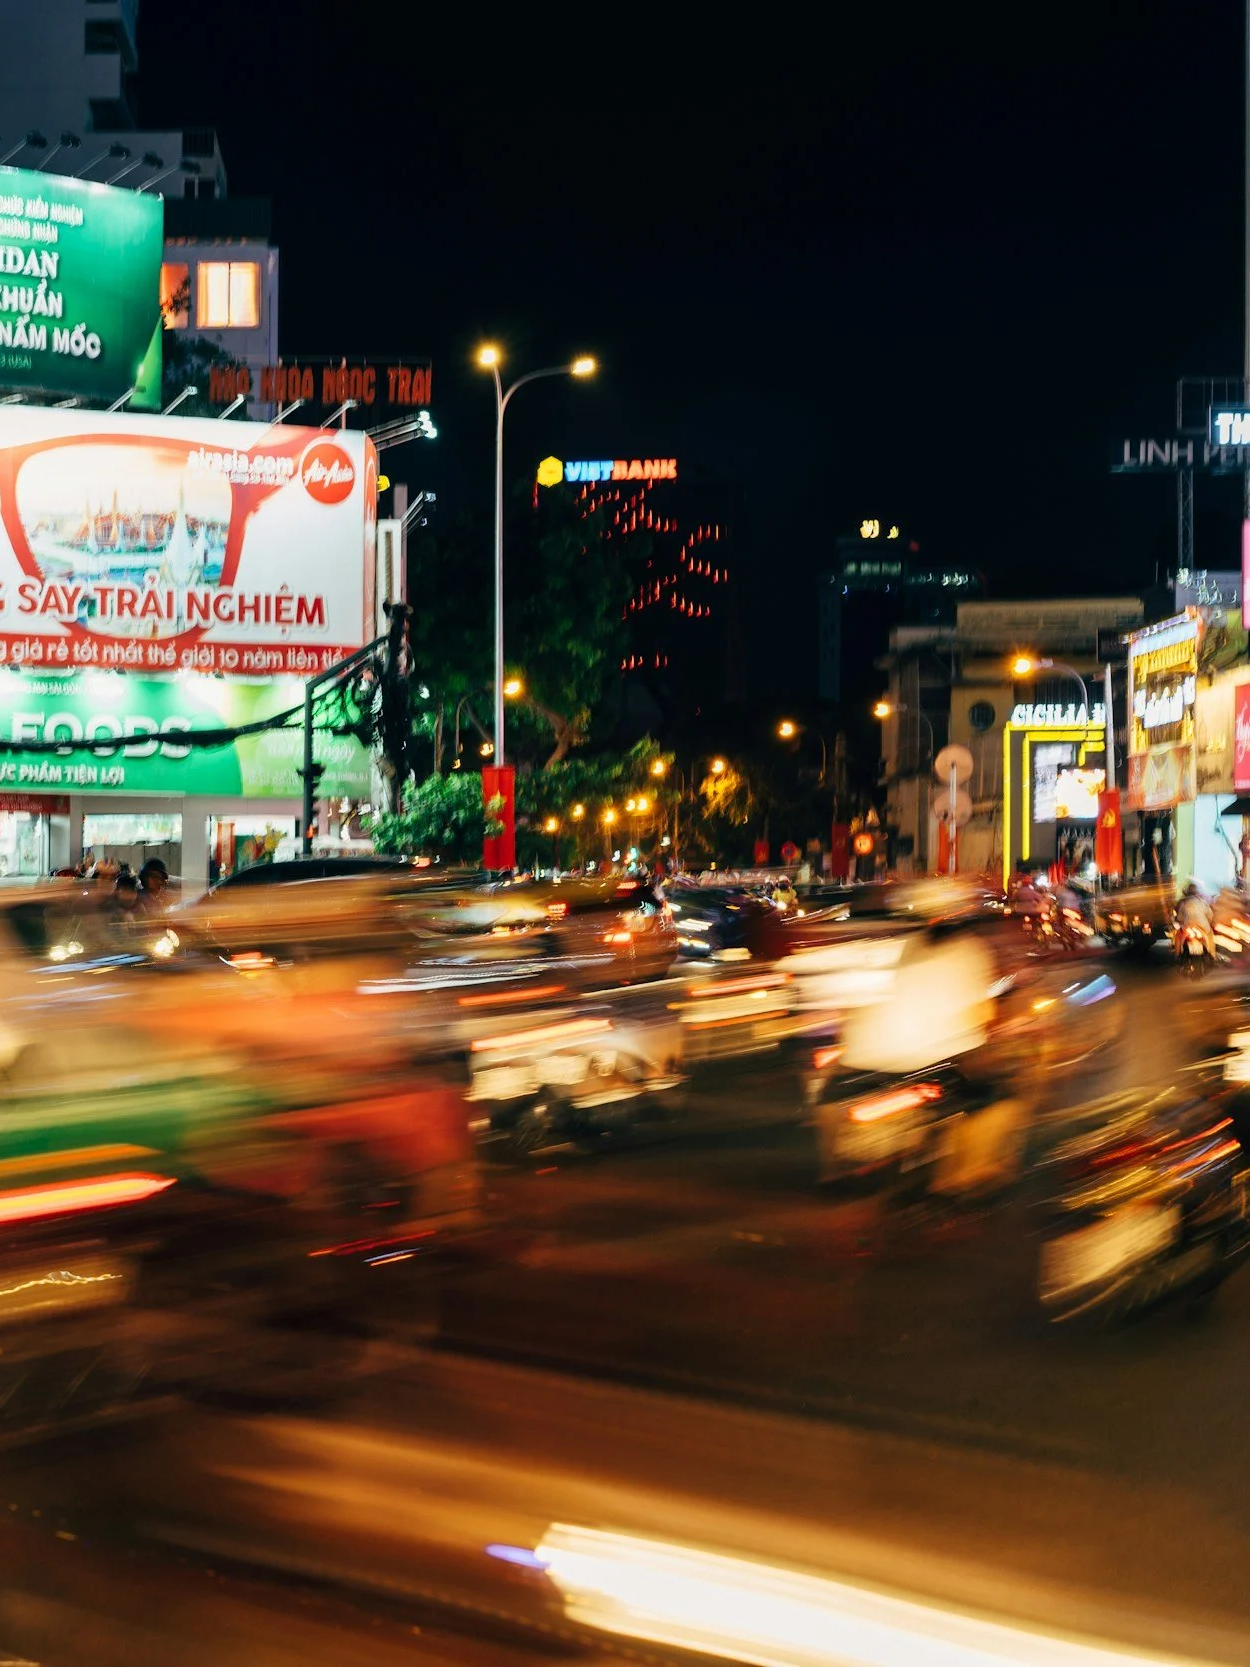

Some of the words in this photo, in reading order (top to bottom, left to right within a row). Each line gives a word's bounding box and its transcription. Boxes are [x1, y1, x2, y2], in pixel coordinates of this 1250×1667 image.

[52, 322, 101, 359] MỐC
[260, 367, 314, 403] KHOA
[387, 367, 433, 405] TRAI
[187, 448, 295, 475] airasia.com
[1124, 438, 1193, 467] LINH
[18, 583, 82, 614] SAY
[94, 575, 174, 619] TRẢI
[187, 583, 326, 634] NGHIỆM
[11, 636, 43, 662] giá
[103, 638, 143, 664] nhất
[147, 639, 177, 666] thế
[219, 649, 238, 668] 10
[243, 646, 283, 669] năm
[323, 646, 349, 670] tiế
